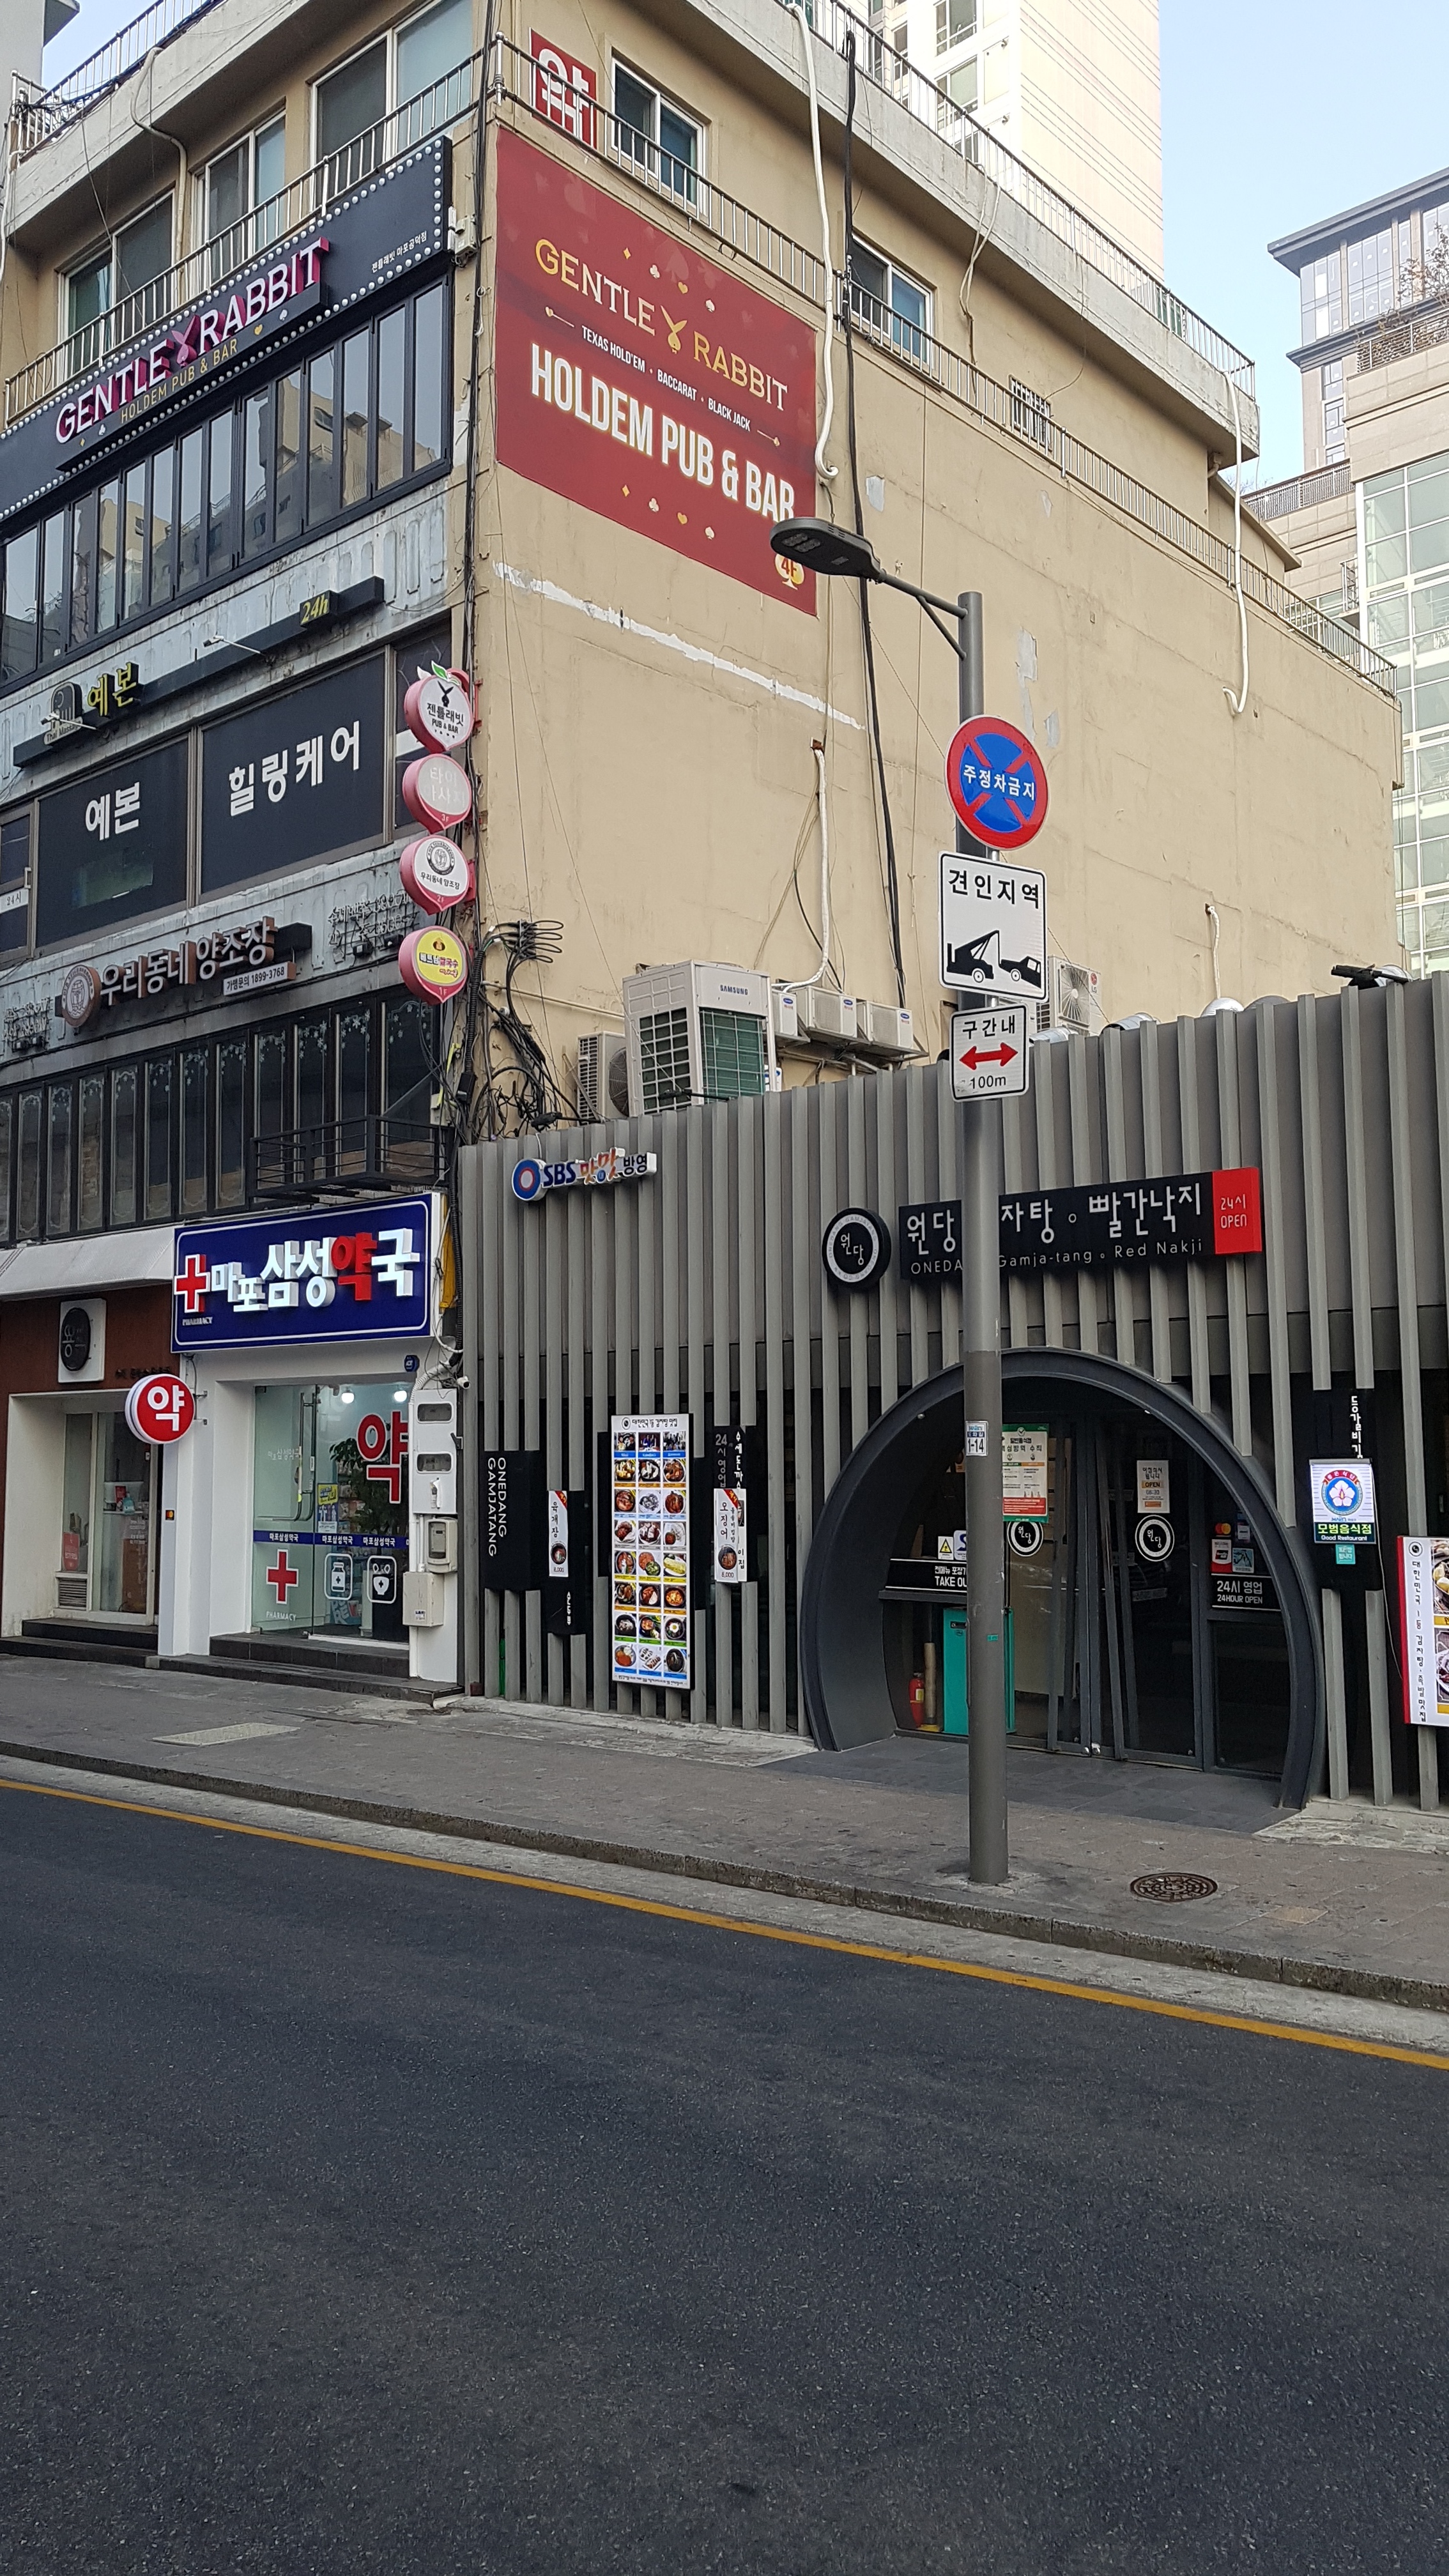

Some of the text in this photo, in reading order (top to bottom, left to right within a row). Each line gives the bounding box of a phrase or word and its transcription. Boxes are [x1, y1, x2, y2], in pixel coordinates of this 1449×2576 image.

[397, 231, 427, 256] 마포공덕점
[535, 239, 788, 411] GENTLE RABBIT
[56, 236, 329, 443] GENTLE RABBIT
[121, 338, 238, 424] HOLDEM PUB & BAR
[582, 325, 751, 431] TEXAS HOLD'EM BACCARAT BLACK JACK
[532, 342, 795, 523] HOLDEM PUB & BAR
[302, 594, 331, 624] 24h
[88, 661, 137, 716] 예본
[427, 703, 464, 726] 젠틀래빗
[432, 718, 442, 728] PUB
[448, 724, 459, 734] BAR
[229, 720, 361, 817] 힐링케어
[963, 763, 1036, 802] 주정차금지
[85, 781, 141, 841] 예본
[441, 813, 449, 823] 3F
[420, 871, 443, 885] 우리동네
[948, 869, 1039, 910] 견인지역
[100, 940, 197, 1006] 우리동네
[195, 915, 279, 980] 양조장
[226, 966, 286, 992] 가맹문의 1899-3768
[439, 986, 448, 996] 1F
[719, 984, 749, 996] SAMSUNG
[970, 1075, 1006, 1089] 100m
[543, 1162, 576, 1188] SBS
[623, 1154, 648, 1176] 방영
[1220, 1194, 1247, 1211] 24시
[907, 1182, 1201, 1256] 원당 자탕 빨간낙지
[1220, 1213, 1248, 1229] OPEN
[841, 1232, 864, 1266] 원당
[910, 1259, 963, 1275] ONEDA
[1114, 1243, 1147, 1259] Red
[1156, 1238, 1202, 1255] Nakji
[211, 1227, 421, 1313] 마포삼성약국
[147, 1385, 186, 1432] 약
[356, 1409, 410, 1504] 약
[968, 1438, 985, 1453] 1-14
[487, 1457, 497, 1557] GAMJATANG
[498, 1457, 507, 1538] ONEDANG
[719, 1501, 729, 1540] 오징어
[1317, 1523, 1372, 1535] 모범음식점
[269, 1532, 299, 1542] 마포삼성약국
[322, 1535, 353, 1545] 마포삼성약국
[363, 1536, 396, 1547] 마포삼성약국
[1018, 1526, 1032, 1544] 원당
[1147, 1529, 1162, 1549] 원당
[934, 1575, 956, 1587] TAKE
[1216, 1580, 1263, 1595] 24시 영업
[1216, 1593, 1263, 1604] 24HOUR OPEN
[265, 1611, 297, 1621] PHARMACY
